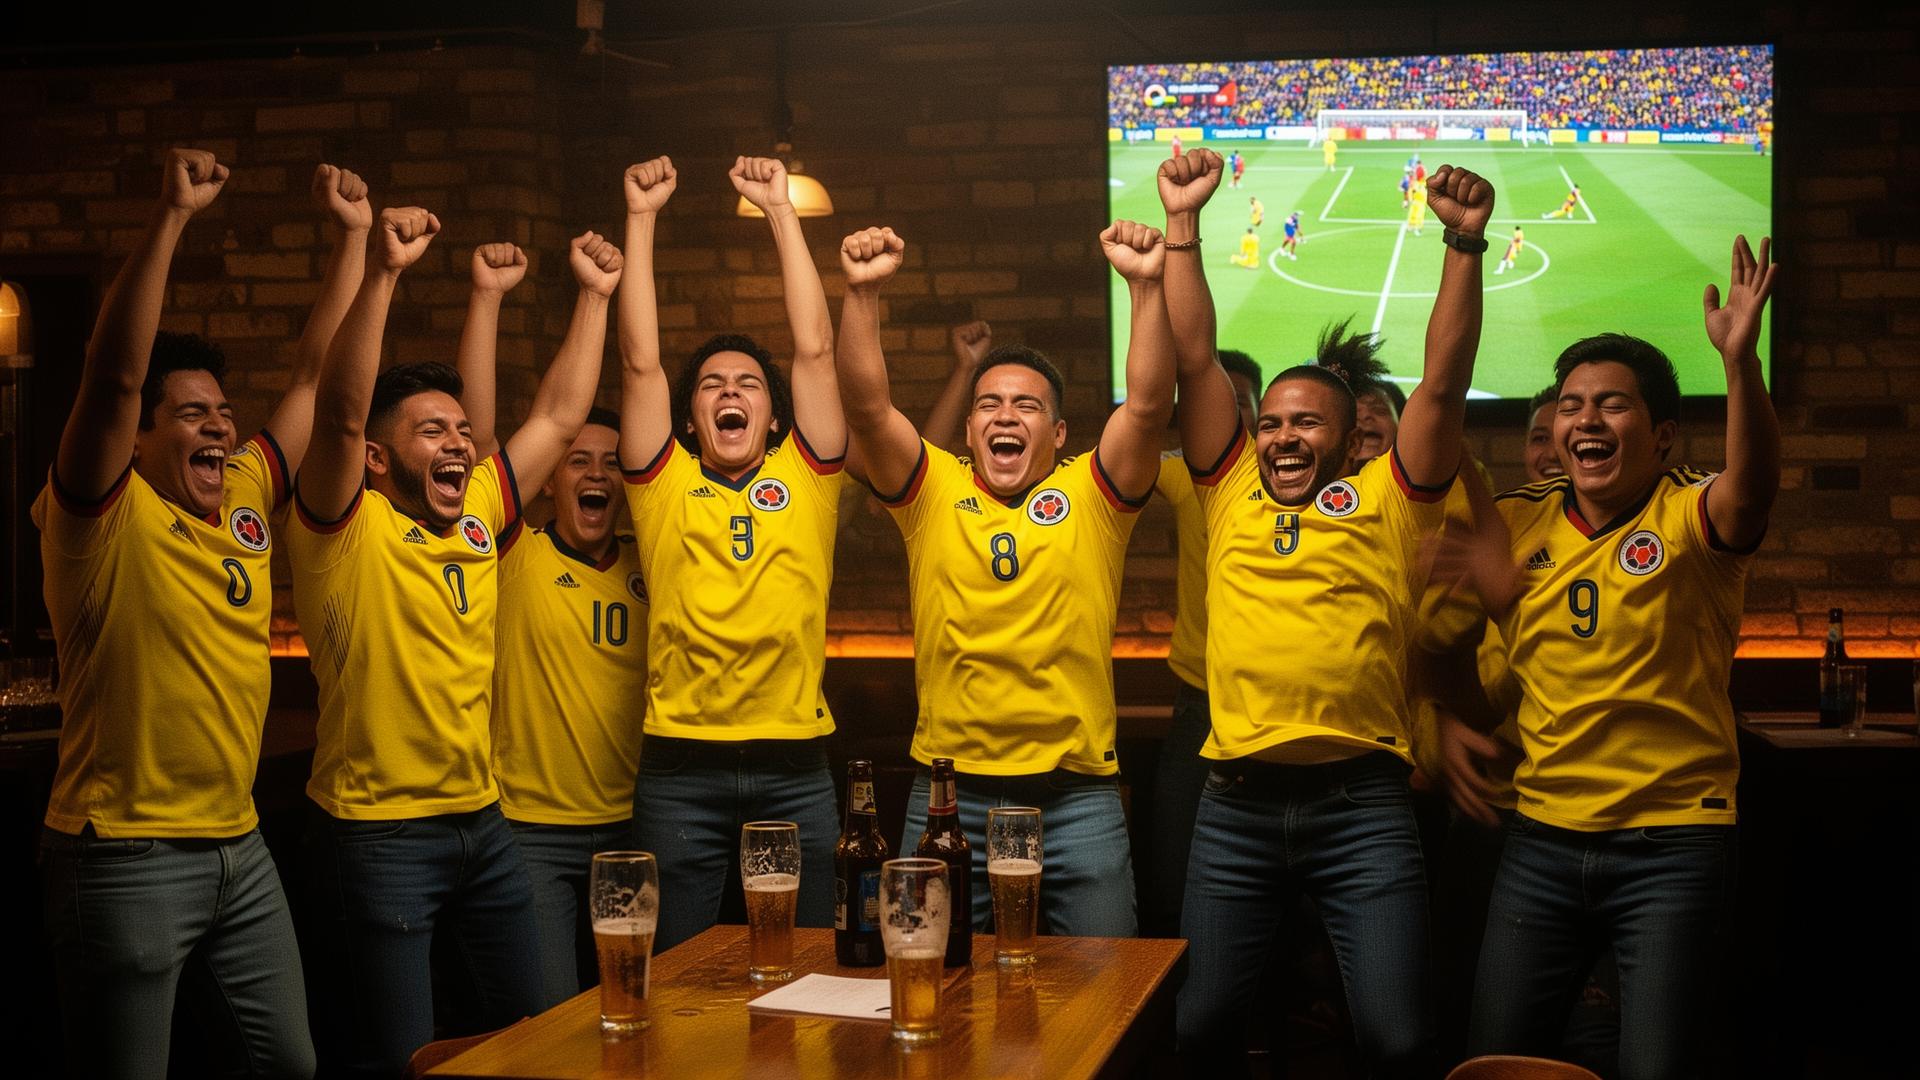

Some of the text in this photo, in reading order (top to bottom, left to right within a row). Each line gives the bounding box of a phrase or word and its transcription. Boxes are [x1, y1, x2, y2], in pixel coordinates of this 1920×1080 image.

[730, 515, 754, 561] 3
[990, 532, 1020, 582] 8
[592, 600, 629, 647] 10
[1568, 578, 1598, 638] 9
